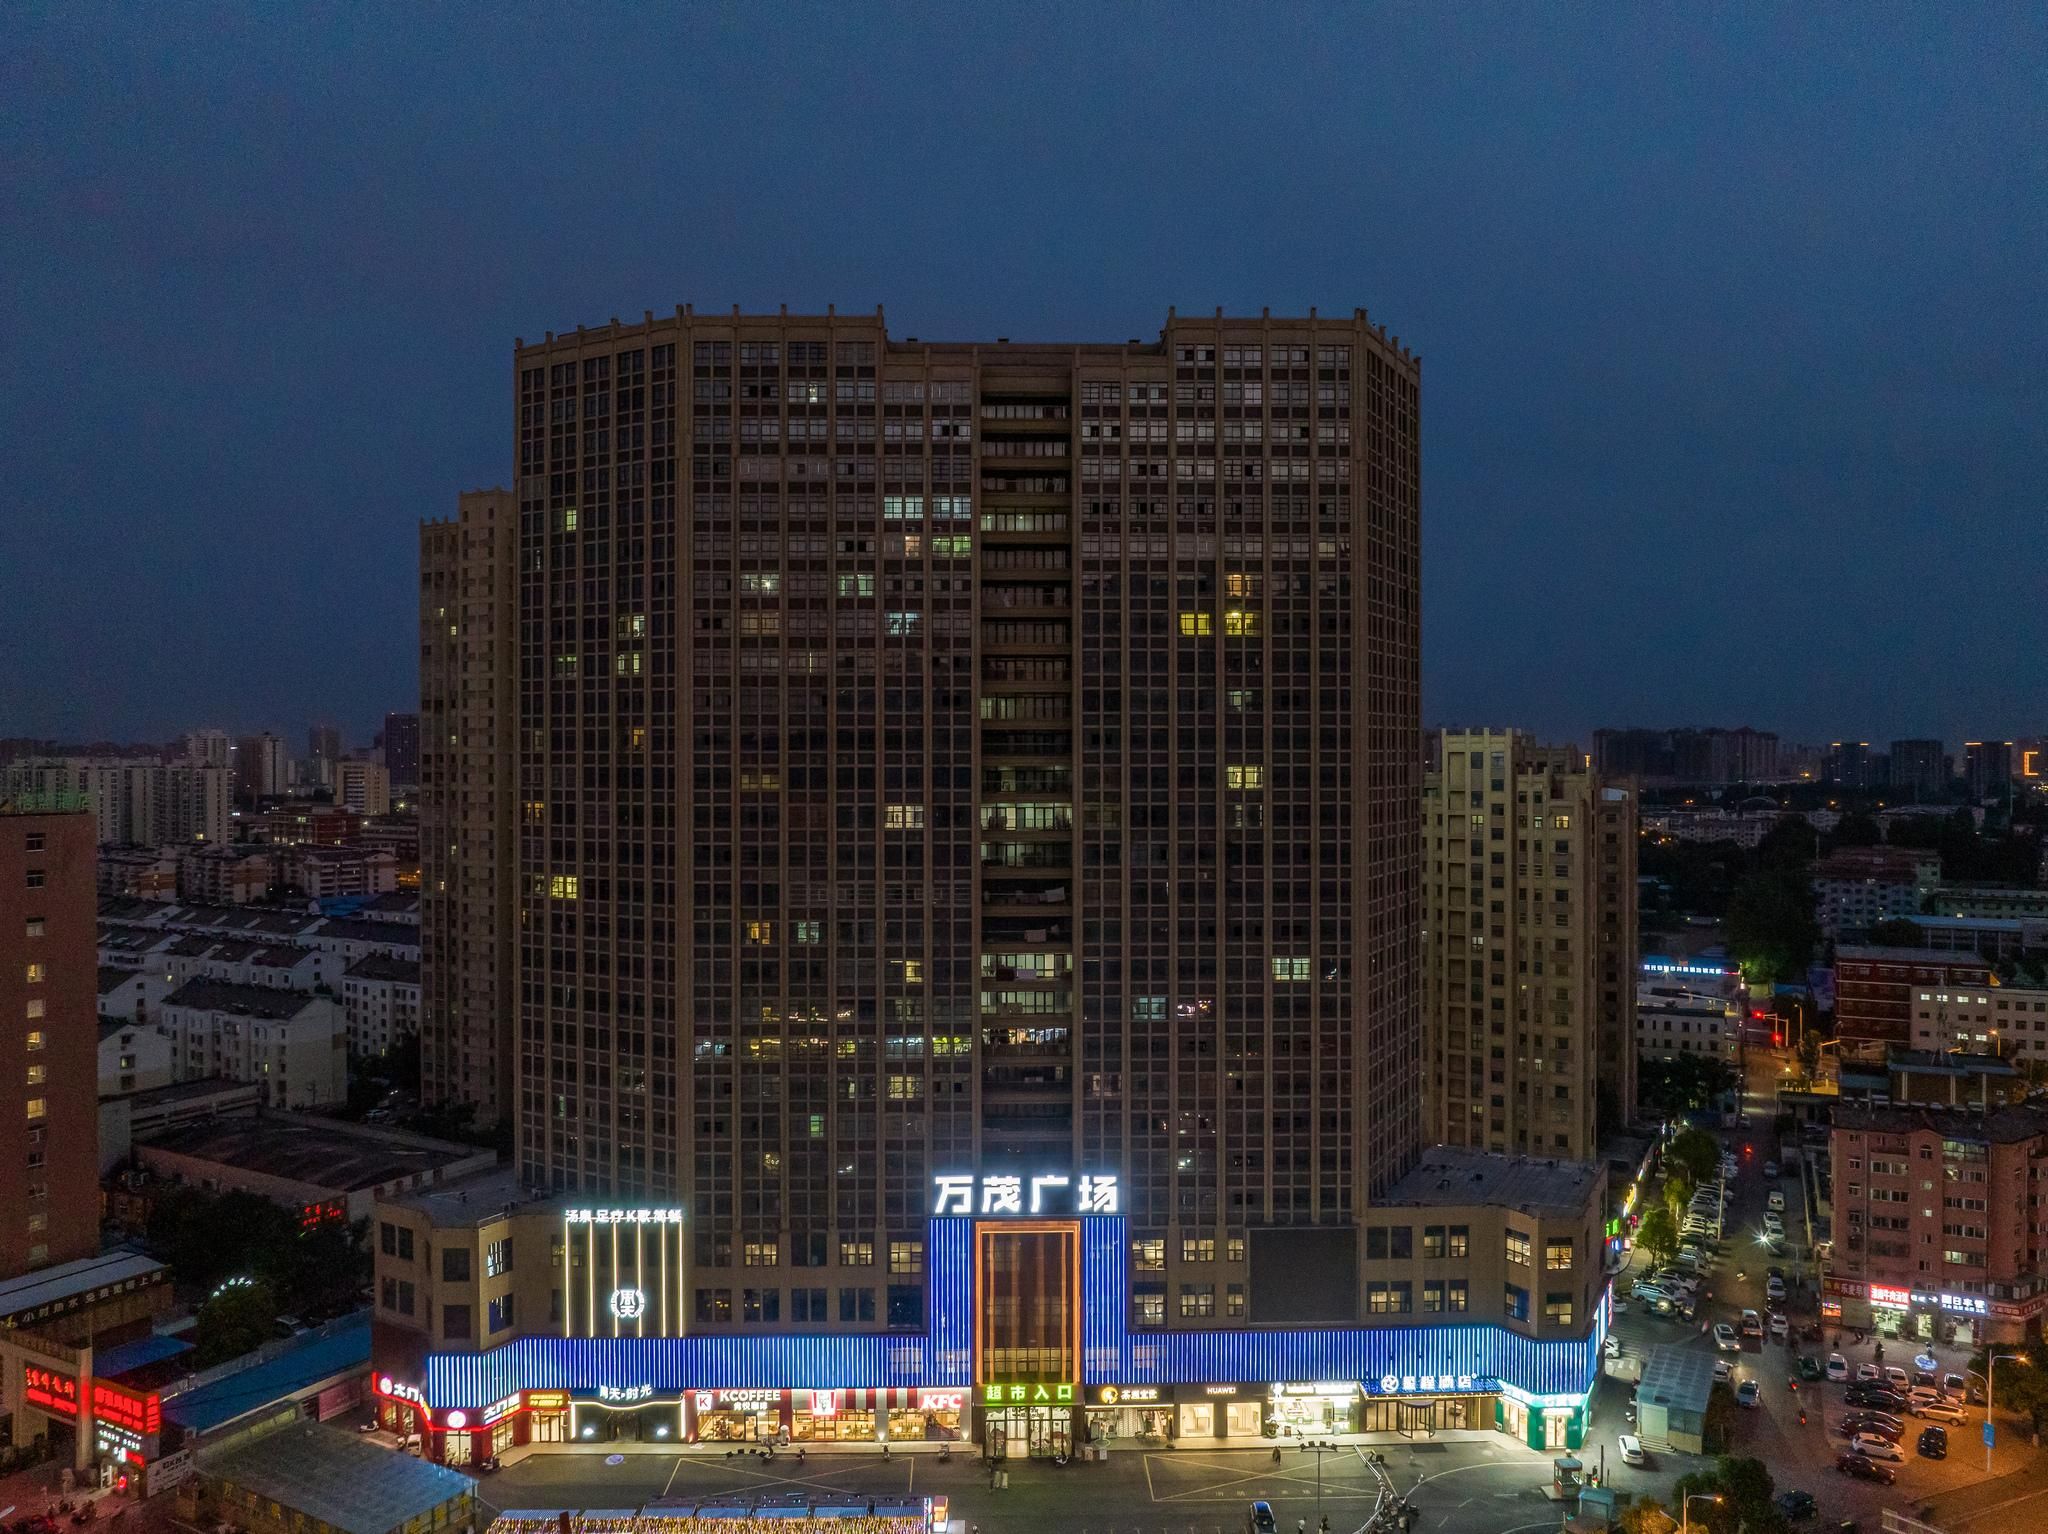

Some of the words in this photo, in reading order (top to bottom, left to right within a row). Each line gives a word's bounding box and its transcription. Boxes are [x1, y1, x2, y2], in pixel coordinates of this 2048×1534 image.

[934, 1175, 1118, 1213] 万茂广场
[720, 1389, 781, 1402] KCOFFEE
[986, 1384, 1073, 1401] 超市入口
[1207, 1387, 1236, 1395] HUAWEI
[699, 1396, 709, 1408] K
[921, 1393, 962, 1409] KFC
